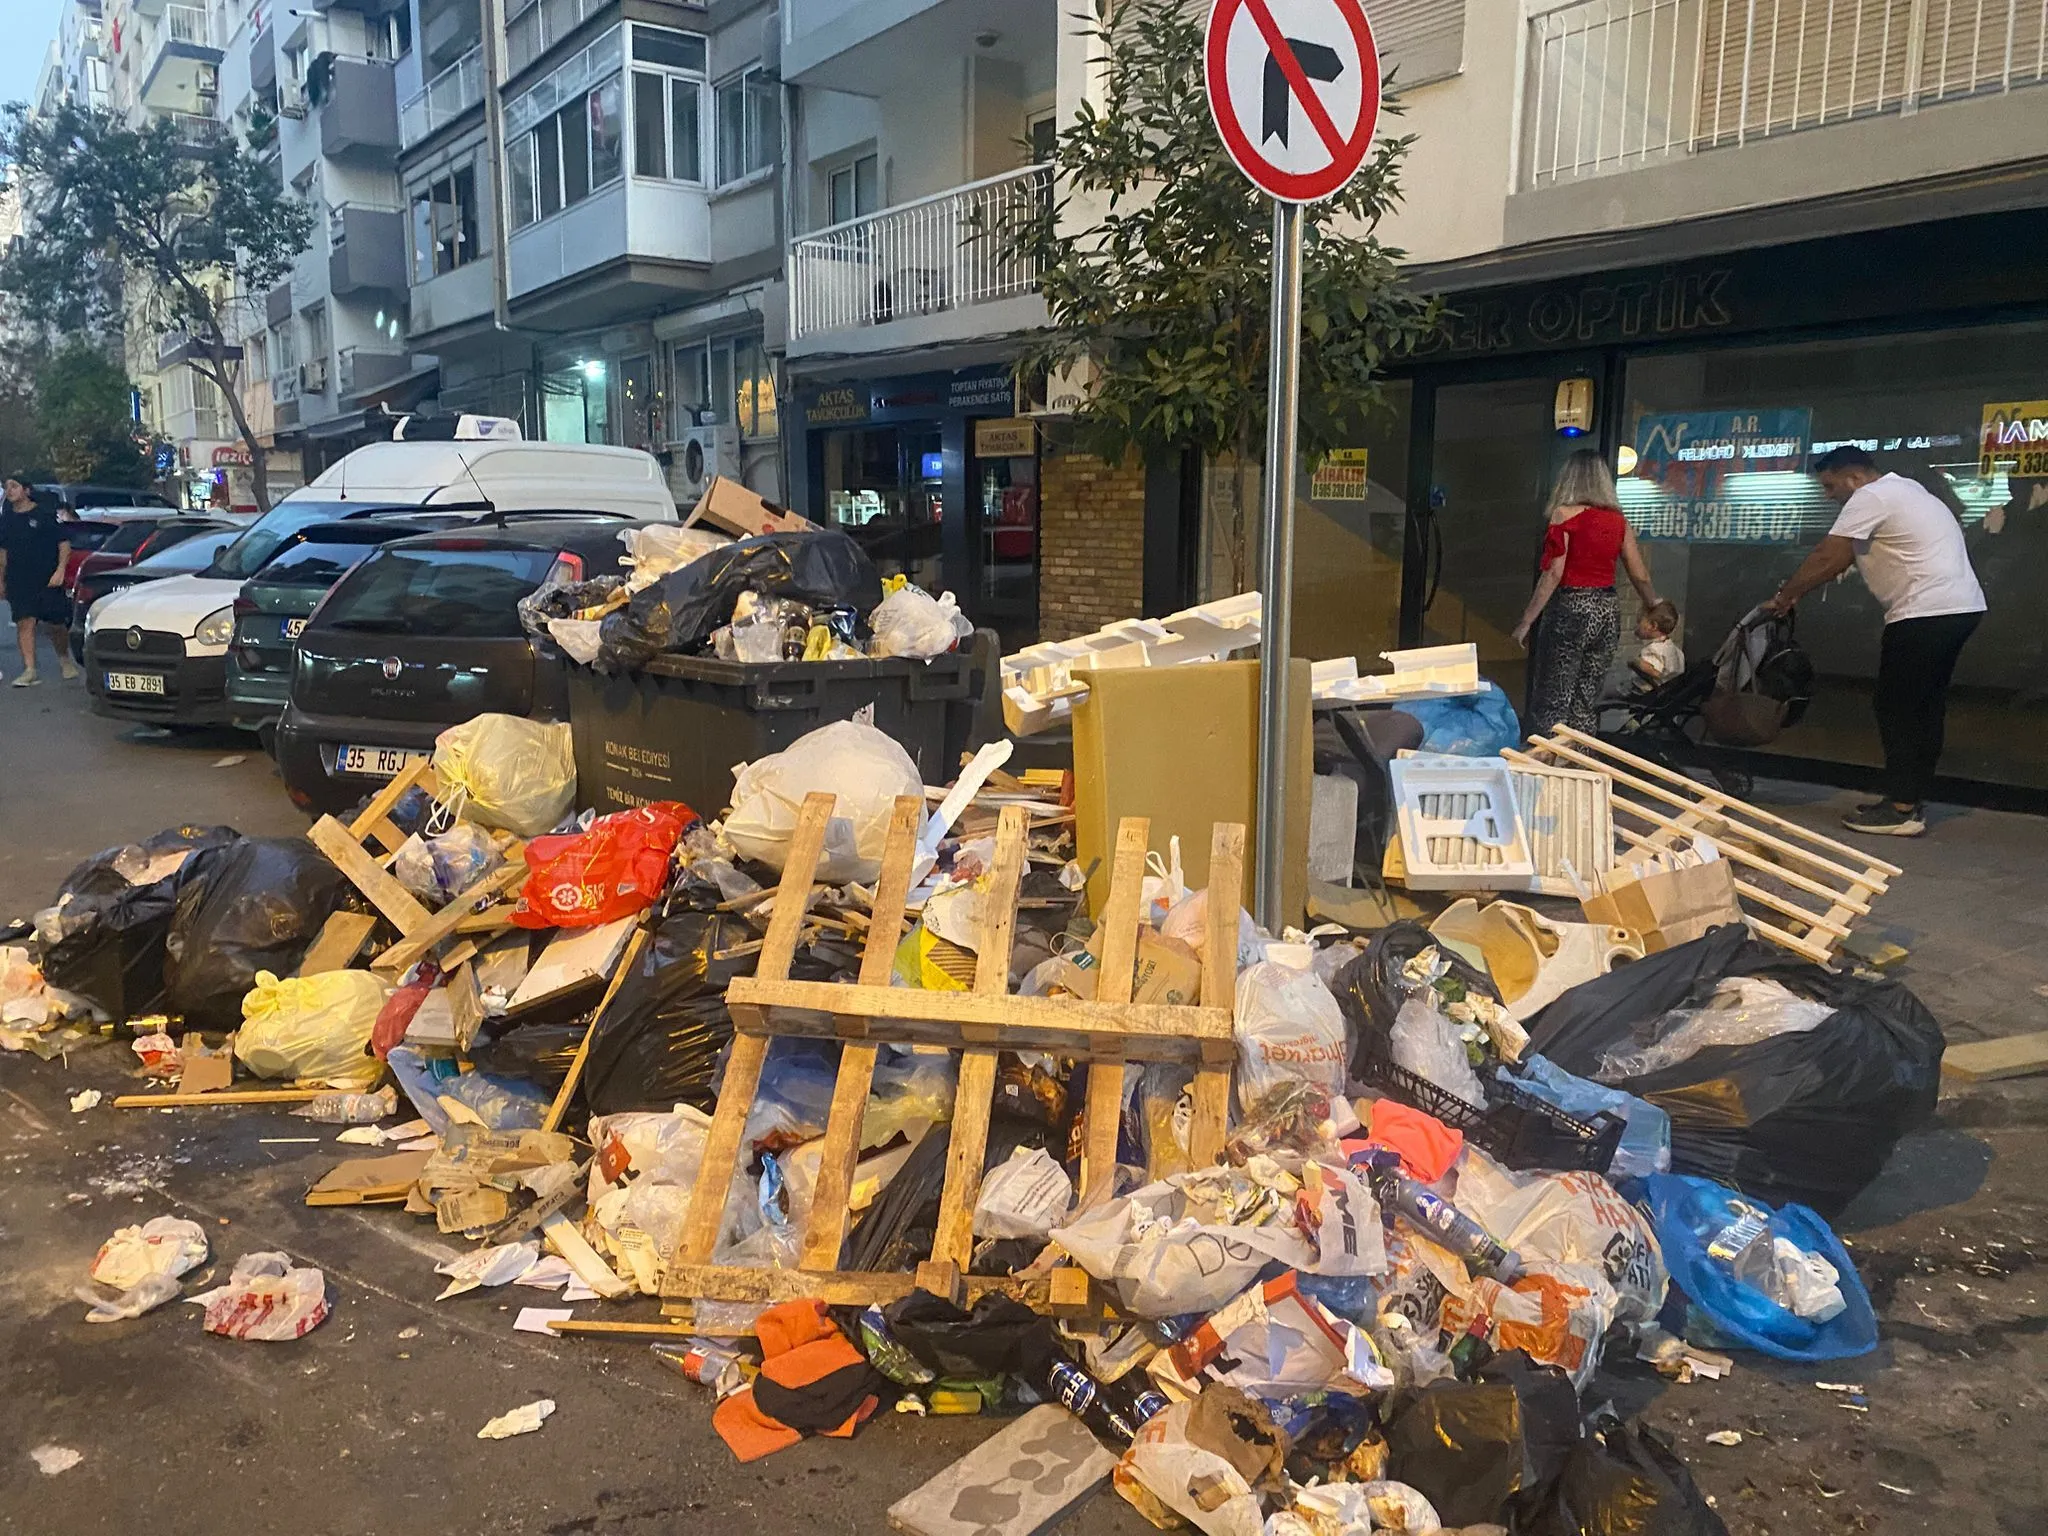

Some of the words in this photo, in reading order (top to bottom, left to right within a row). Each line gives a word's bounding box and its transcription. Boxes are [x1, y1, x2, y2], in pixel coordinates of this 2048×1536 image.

[1529, 266, 1732, 343] OPTİK
[288, 621, 301, 636] 45
[110, 675, 121, 689] 35
[125, 675, 136, 690] EB
[347, 748, 365, 768] 35
[377, 750, 407, 773] RGJ
[604, 740, 628, 759] KONAK
[628, 746, 671, 769] BELEDİYESİ
[1061, 1371, 1089, 1412] EFES
